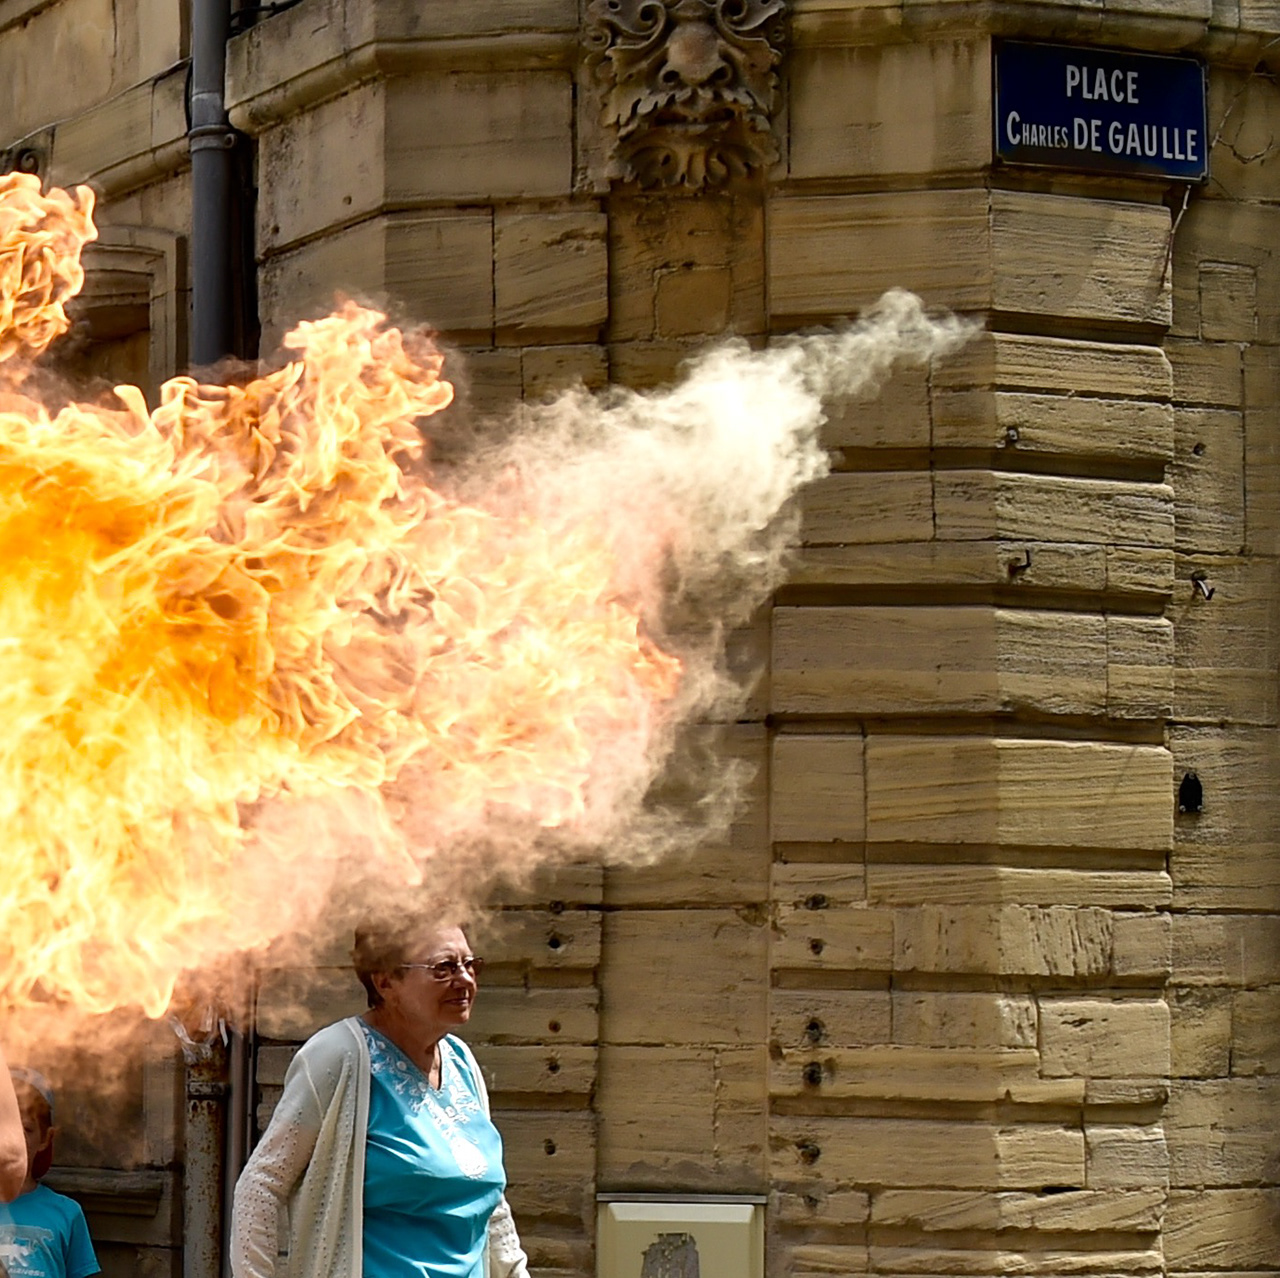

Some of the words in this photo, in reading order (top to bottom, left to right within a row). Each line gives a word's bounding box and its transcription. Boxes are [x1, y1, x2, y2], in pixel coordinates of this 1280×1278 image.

[1066, 64, 1139, 104] PLACE
[1073, 117, 1102, 153] DE
[1108, 121, 1198, 162] GAULLE
